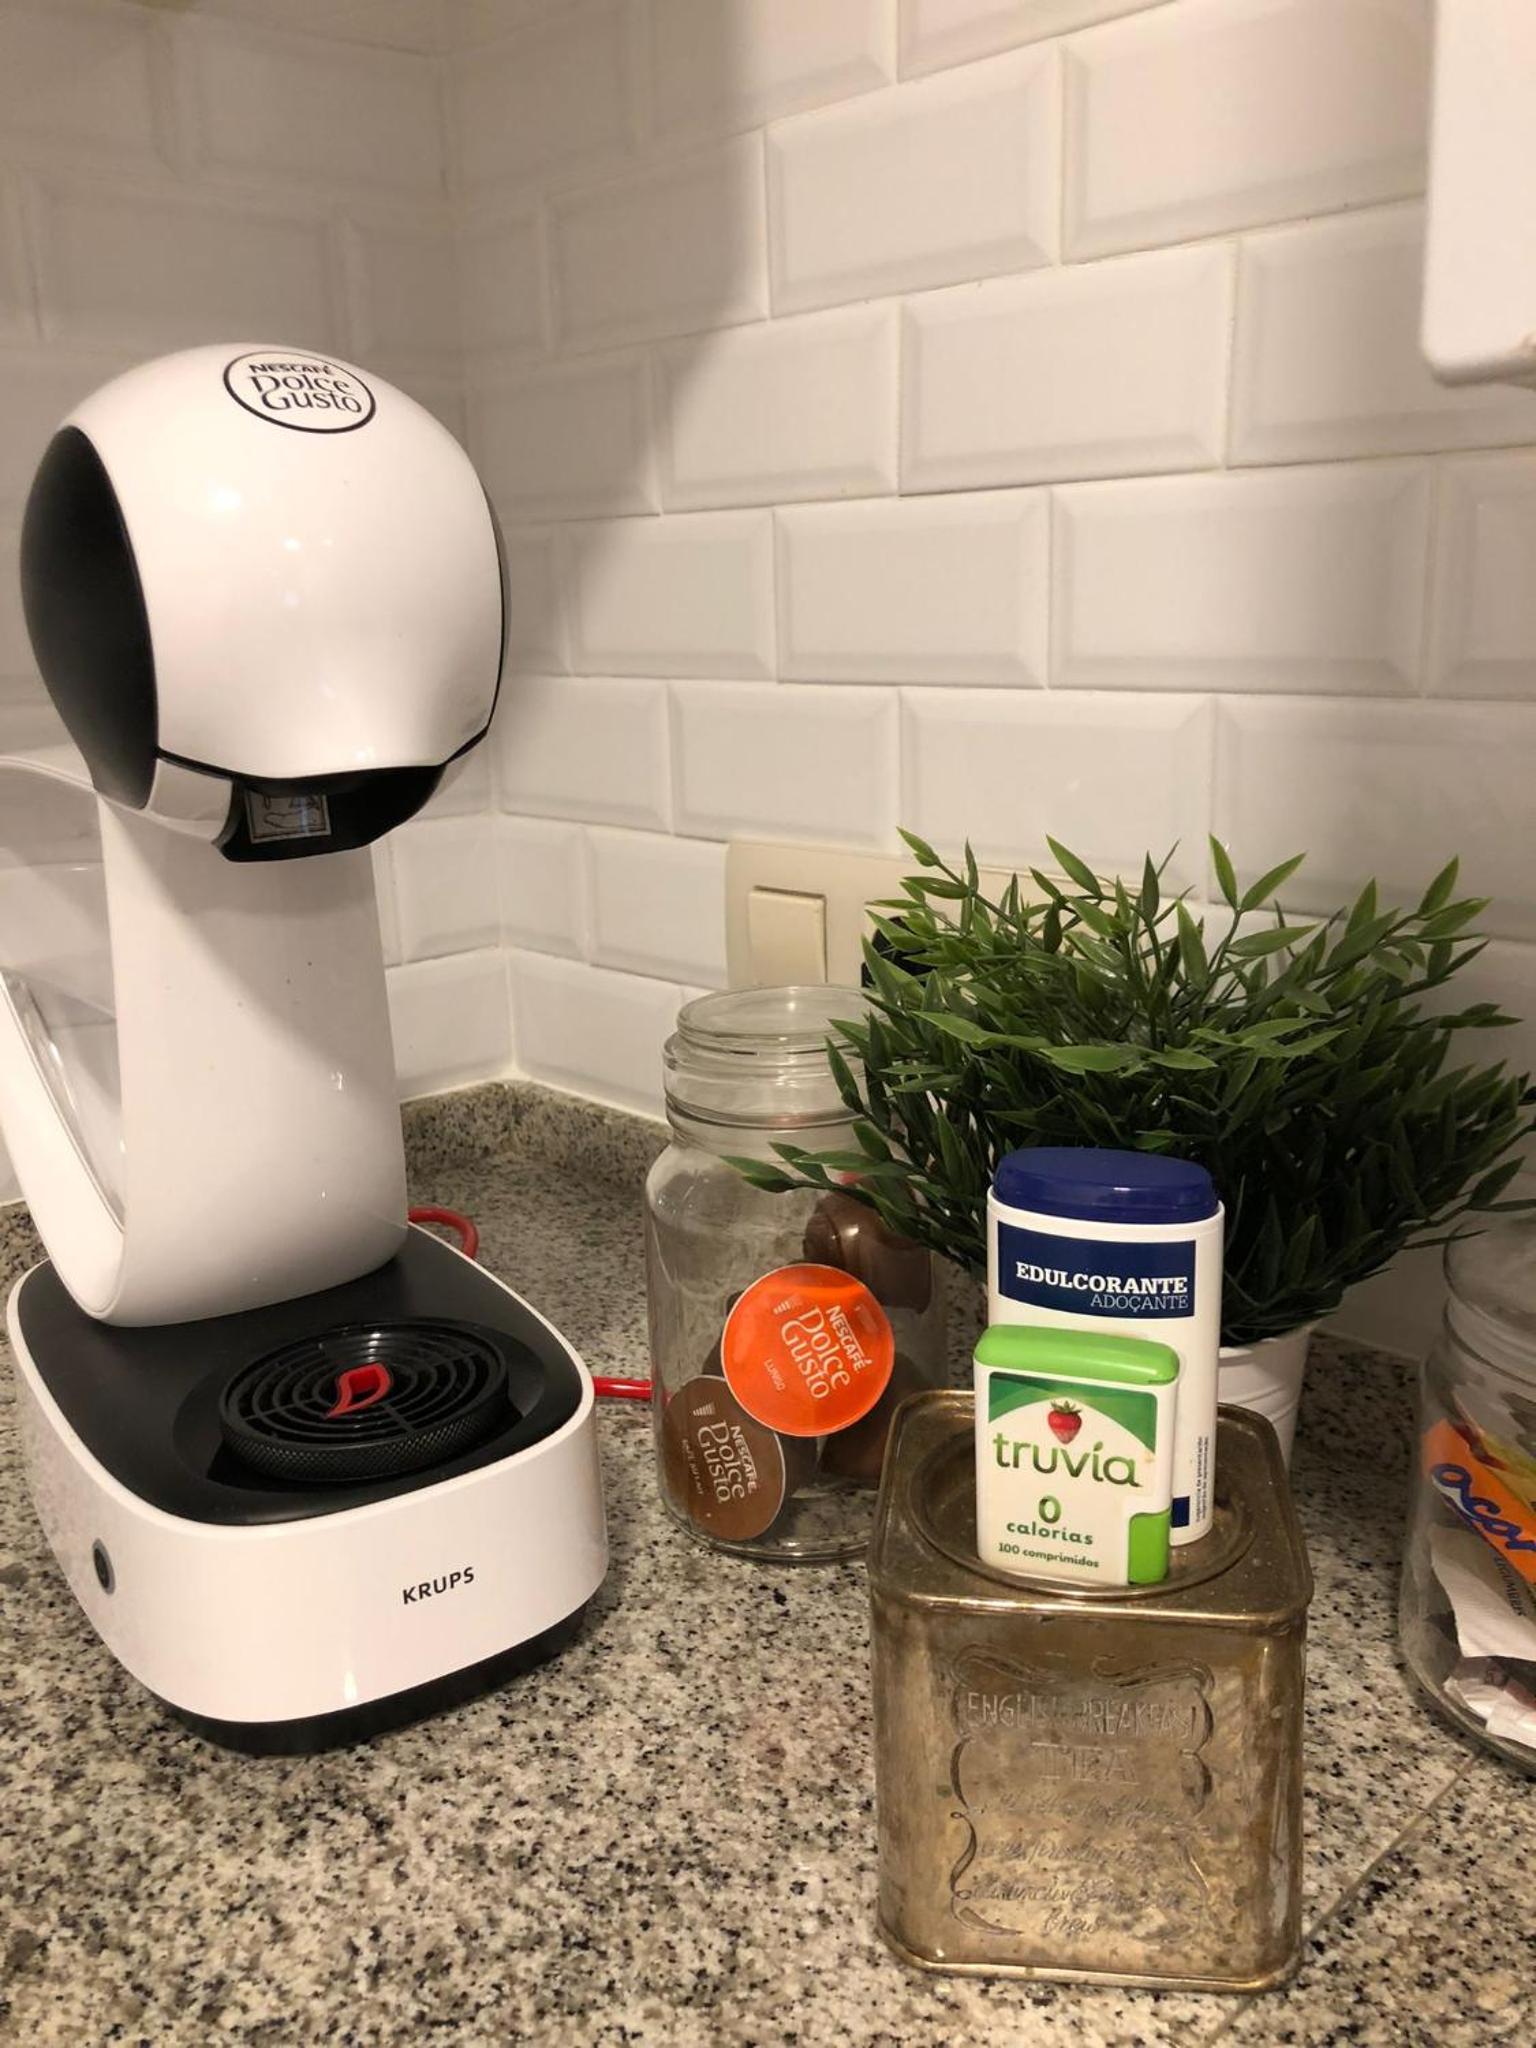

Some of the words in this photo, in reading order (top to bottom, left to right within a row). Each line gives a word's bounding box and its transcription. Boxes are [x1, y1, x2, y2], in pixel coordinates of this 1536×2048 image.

[250, 374, 351, 395] Dolce
[261, 390, 362, 413] Gusto
[1016, 1261, 1188, 1294] EDULCORANTE
[1090, 1293, 1189, 1313] ADOÇANTE
[797, 1305, 851, 1390] Dolce
[826, 1305, 873, 1374] NESCAFÉ
[781, 1320, 830, 1399] Gusto
[698, 1426, 731, 1504] Gusto
[709, 1419, 745, 1499] Dolce
[998, 1542, 1020, 1555] 100
[1022, 1551, 1100, 1568] comprimidos
[402, 1566, 475, 1605] KRUPS
